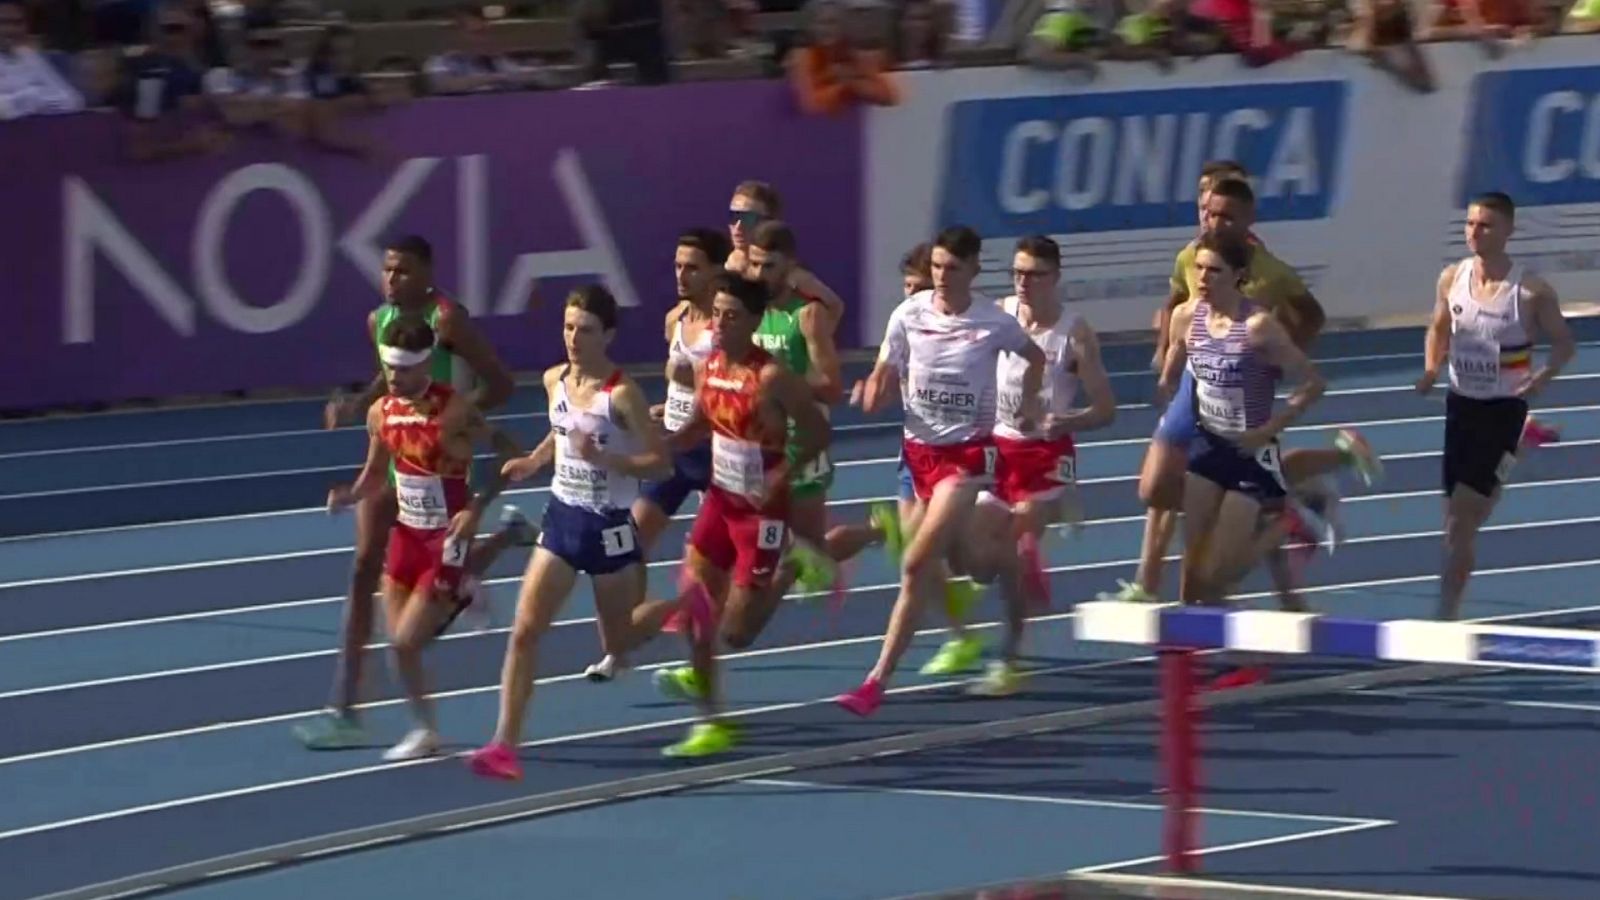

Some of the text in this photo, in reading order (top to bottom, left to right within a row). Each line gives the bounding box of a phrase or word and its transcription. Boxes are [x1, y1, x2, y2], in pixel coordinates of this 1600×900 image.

[1000, 107, 1318, 213] CONICA
[61, 147, 640, 343] NOKIA
[1456, 359, 1497, 374] ADAM
[917, 389, 975, 407] MEGIER
[1261, 448, 1272, 465] 4
[613, 531, 623, 549] 1
[765, 525, 777, 545] 8
[453, 541, 462, 561] 3
